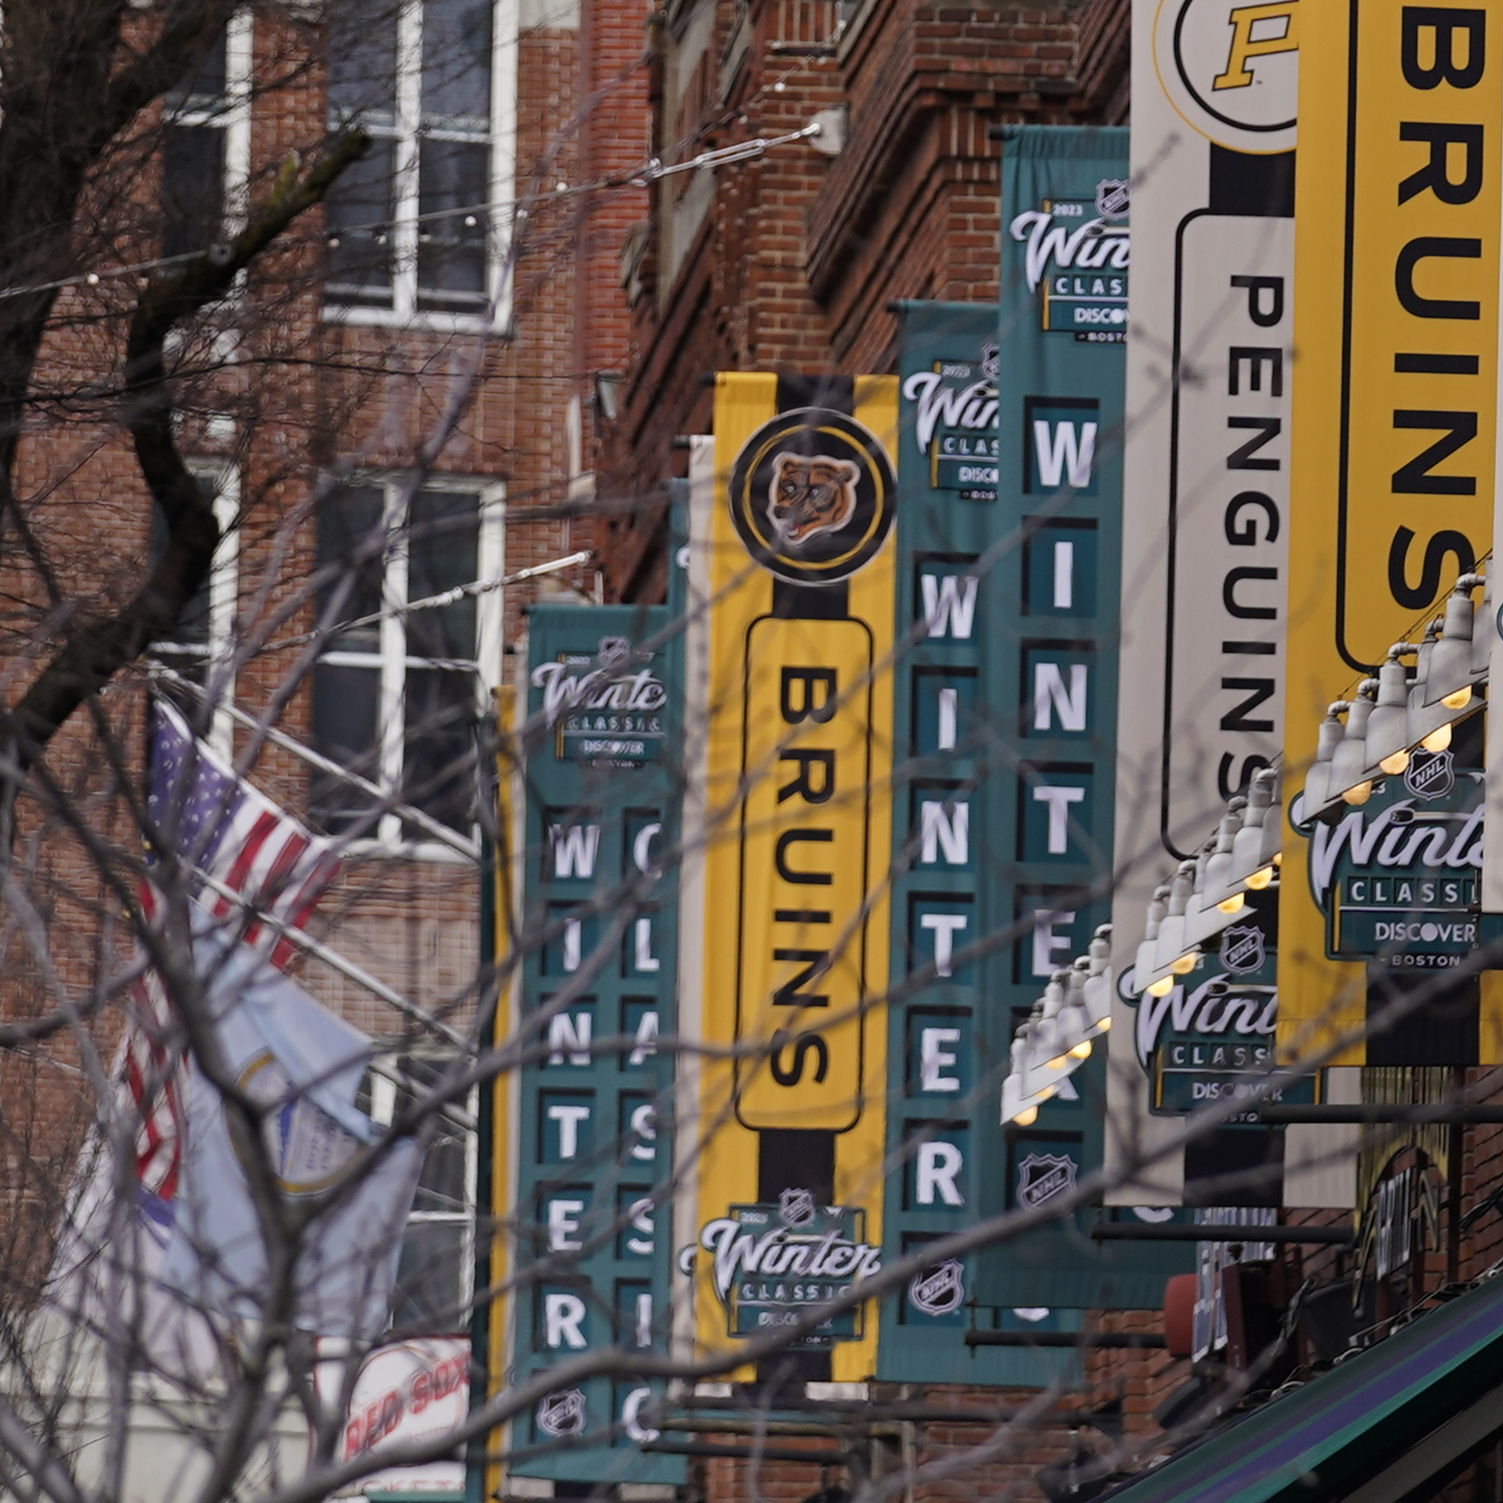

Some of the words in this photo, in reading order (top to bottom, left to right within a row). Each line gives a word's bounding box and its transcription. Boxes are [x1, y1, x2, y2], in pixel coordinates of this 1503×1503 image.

[1388, 6, 1487, 611] BRUINS
[1217, 275, 1284, 804] PENGUINS
[770, 665, 838, 1088] BRUINS
[1414, 760, 1446, 787] NHL
[1375, 922, 1476, 942] DISCOVER
[701, 1218, 882, 1304] Winter
